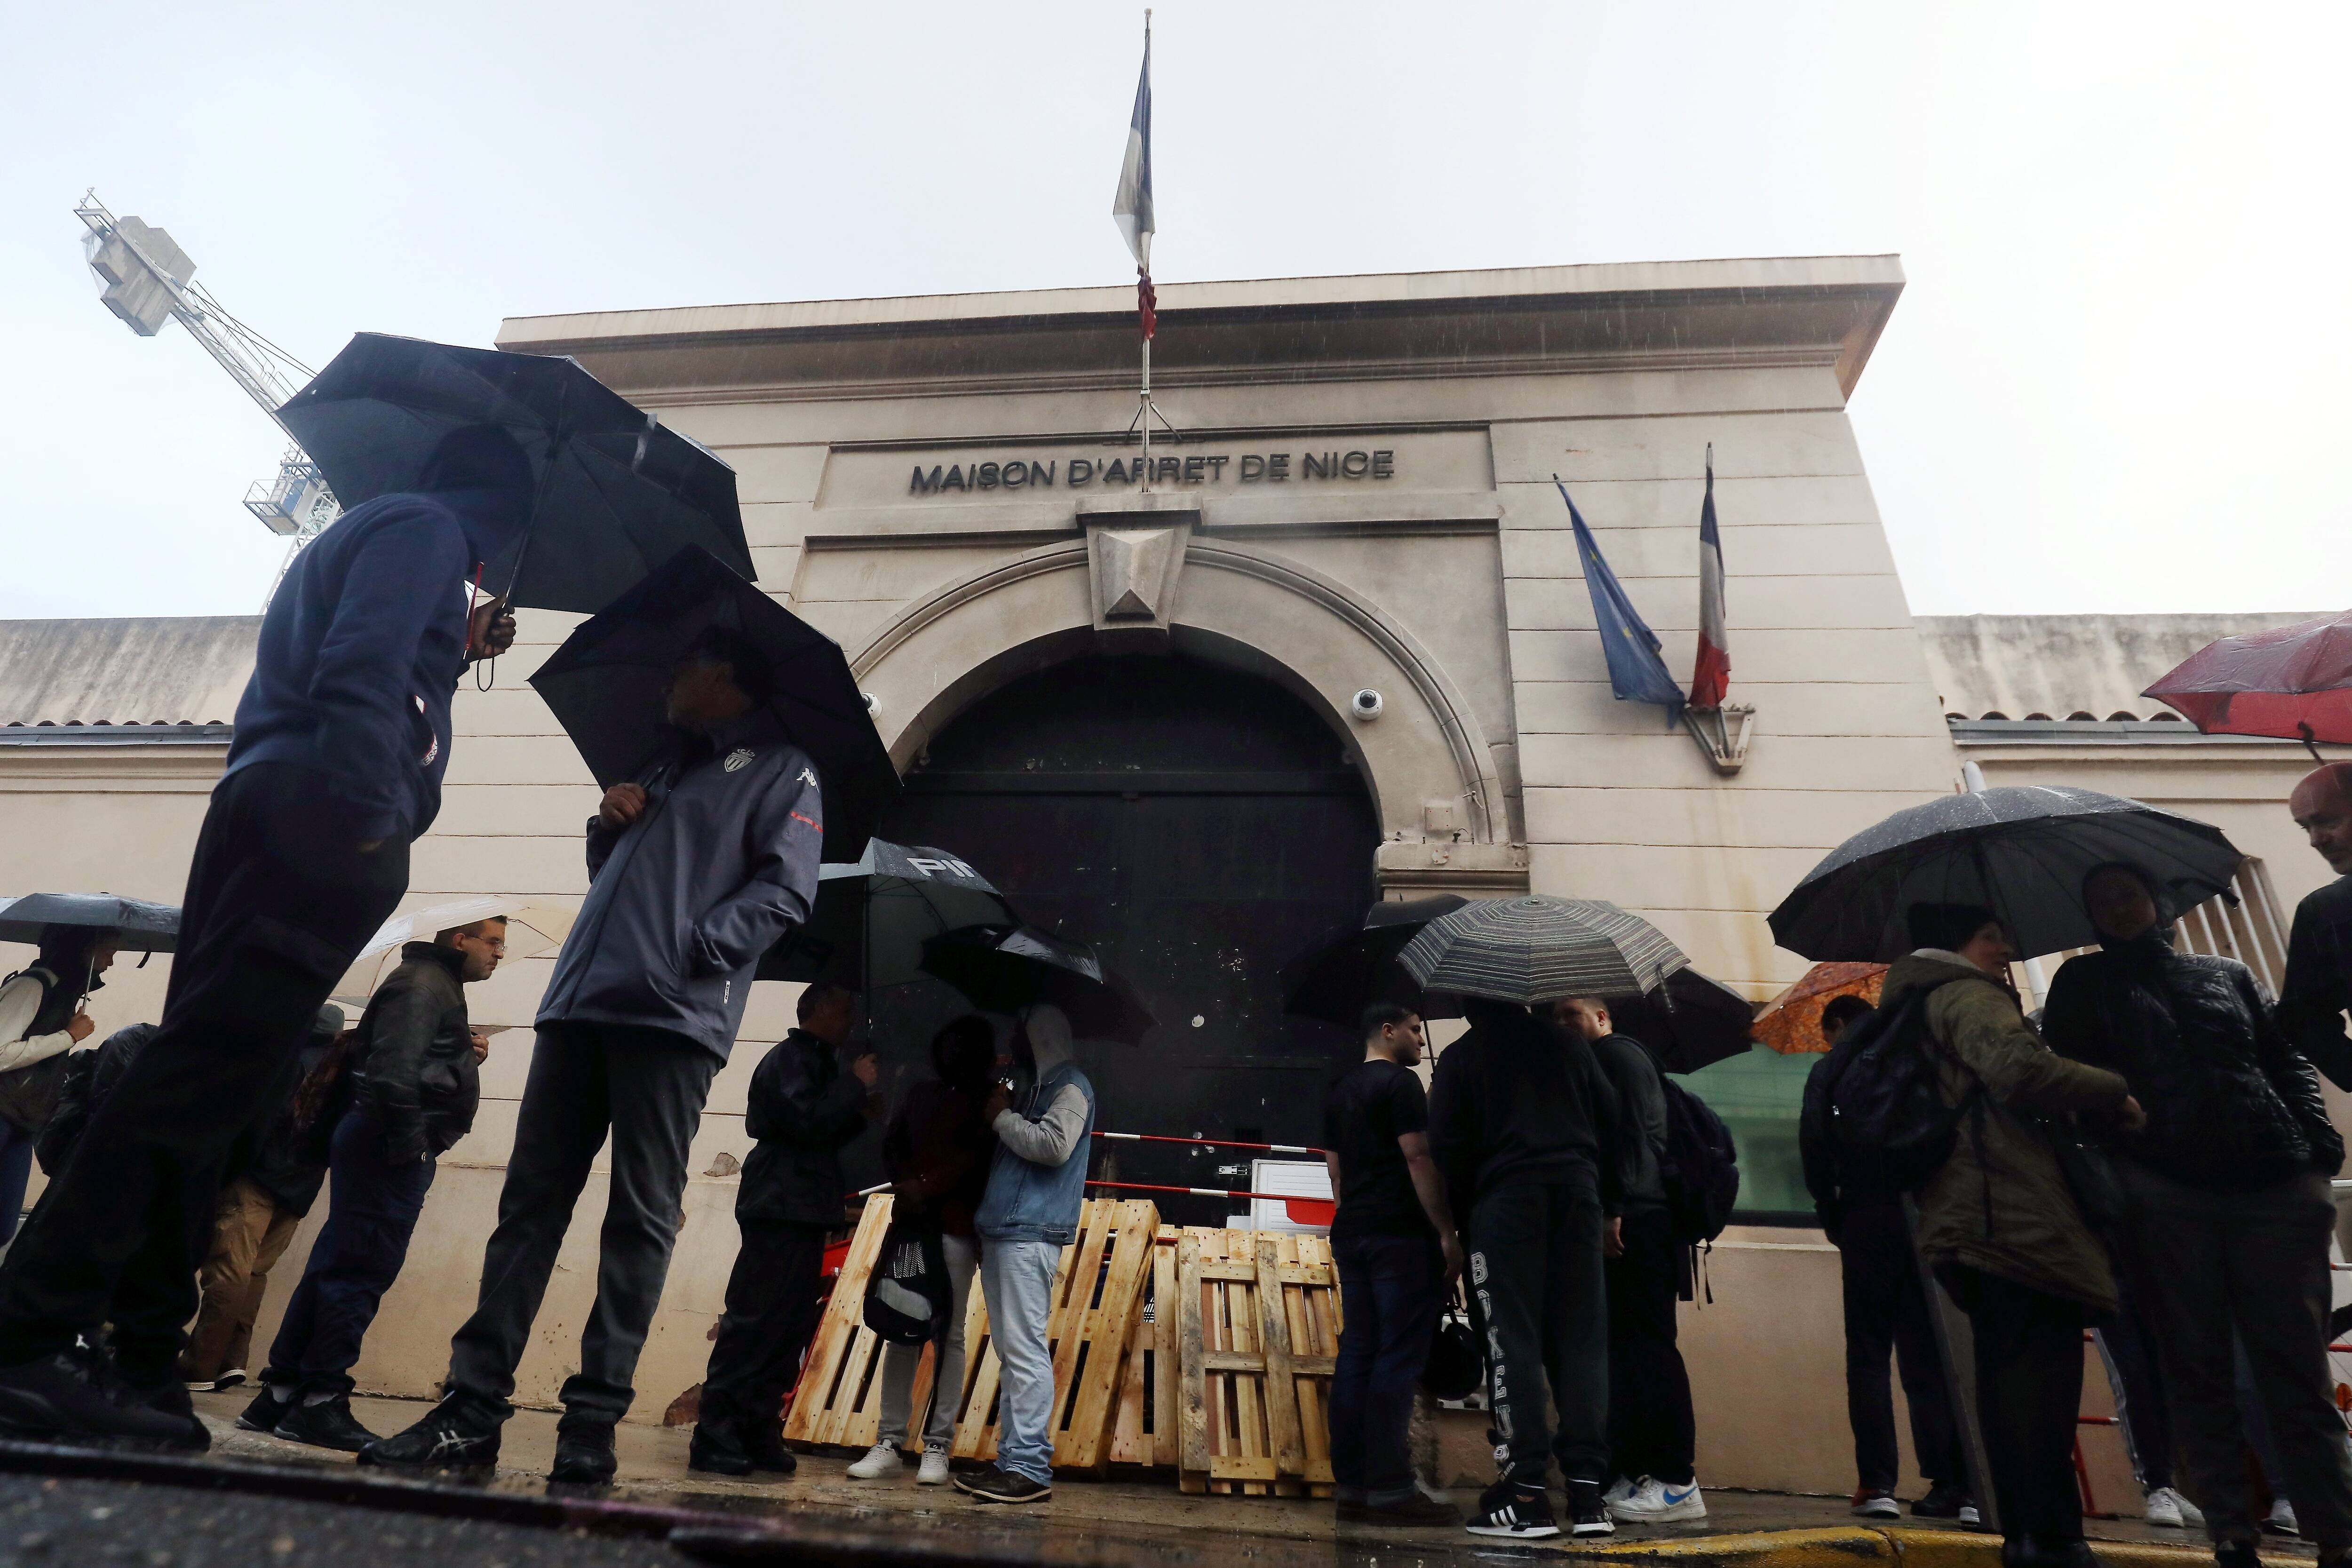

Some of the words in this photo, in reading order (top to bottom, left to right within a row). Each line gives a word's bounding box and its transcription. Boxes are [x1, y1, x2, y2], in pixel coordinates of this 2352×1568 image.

[211, 327, 229, 348] RIVIERA
[911, 460, 1055, 488] MAISON
[1068, 455, 1229, 484] D'ARRET
[1241, 454, 1290, 479] DE
[1304, 450, 1394, 479] NICE
